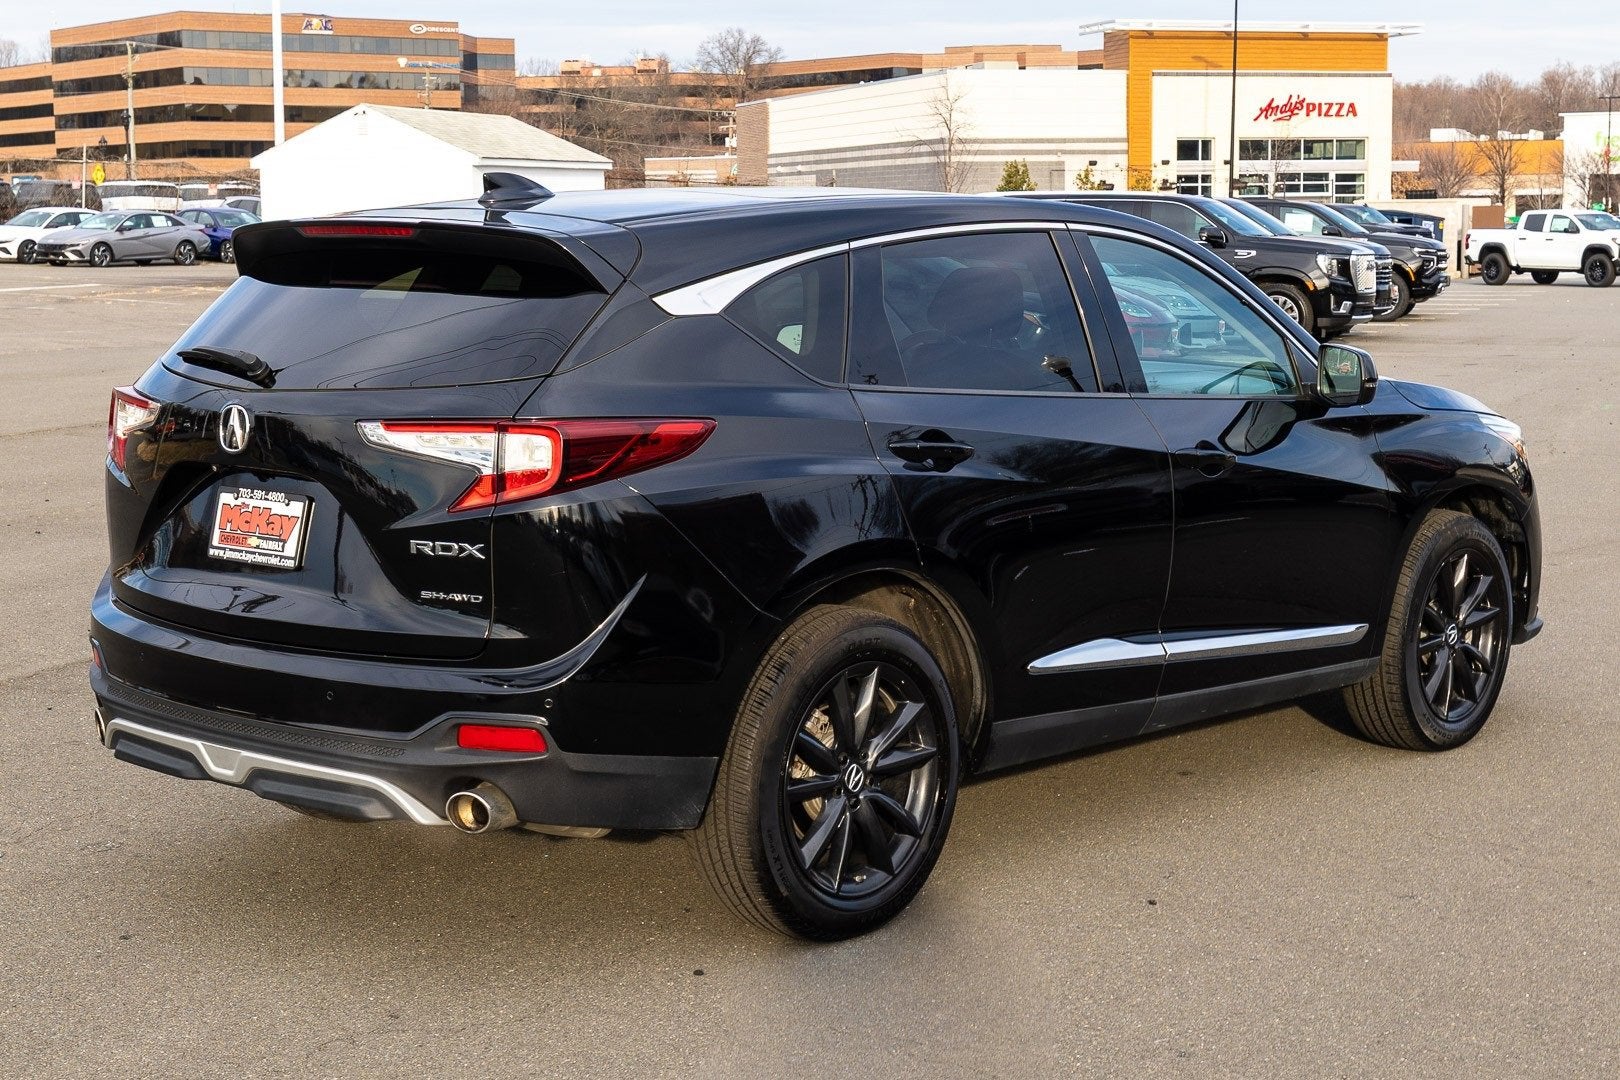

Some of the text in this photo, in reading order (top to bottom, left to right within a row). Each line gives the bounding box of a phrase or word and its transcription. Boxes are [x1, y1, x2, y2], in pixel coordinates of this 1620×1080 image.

[1253, 94, 1358, 122] Andy's PIZZA
[239, 487, 285, 503] 703-591-4800
[219, 502, 300, 544] McKay
[220, 534, 248, 546] CHEVROLET
[259, 539, 284, 552] FAIRFAX
[410, 540, 486, 559] RDX
[420, 590, 483, 603] SH-AWD
